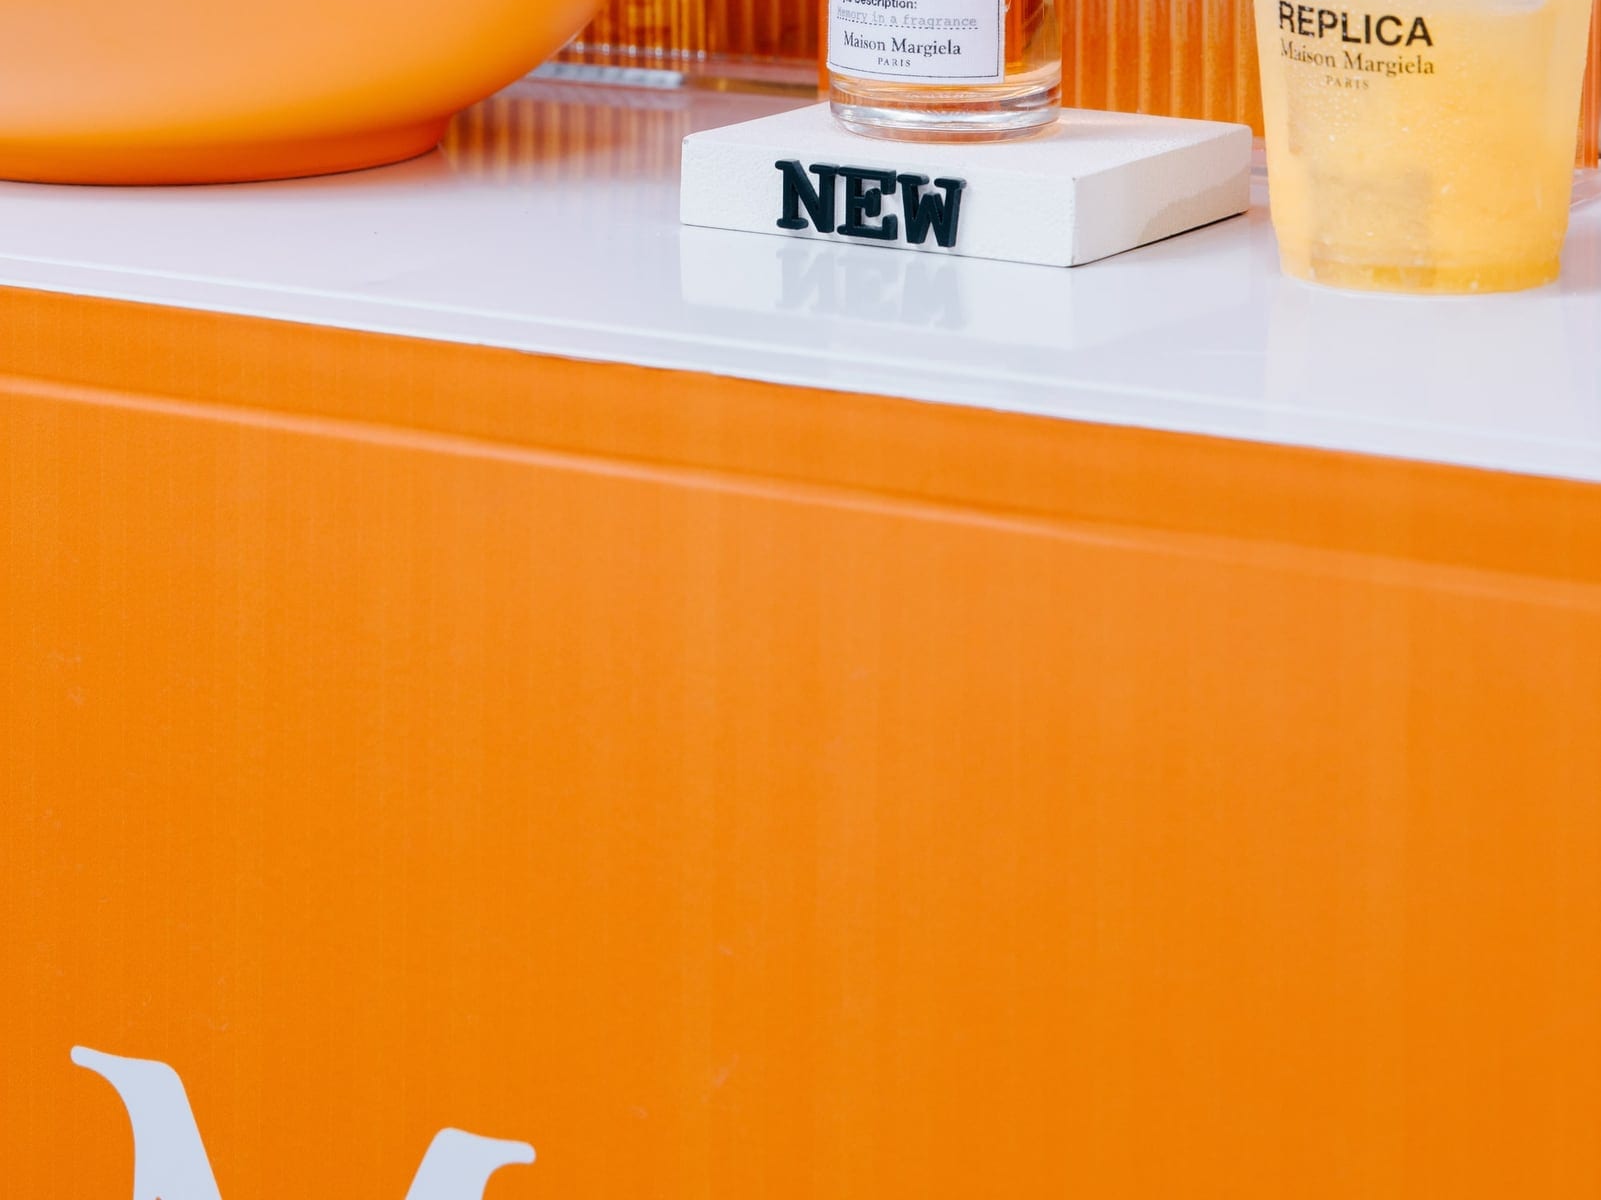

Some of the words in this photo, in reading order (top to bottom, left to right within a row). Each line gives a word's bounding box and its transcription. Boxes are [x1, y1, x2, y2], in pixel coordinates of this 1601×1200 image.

[836, 6, 868, 23] Memory
[872, 11, 885, 23] in
[890, 15, 898, 24] a
[903, 14, 977, 30] fragrance
[1278, 0, 1434, 48] REPLICA
[843, 30, 886, 52] Maison
[891, 37, 962, 57] Margiela
[1280, 37, 1337, 68] Maison
[1343, 50, 1435, 77] Margiela
[877, 57, 912, 67] PARIS
[1325, 75, 1370, 90] PARIS
[774, 158, 967, 248] NEW
